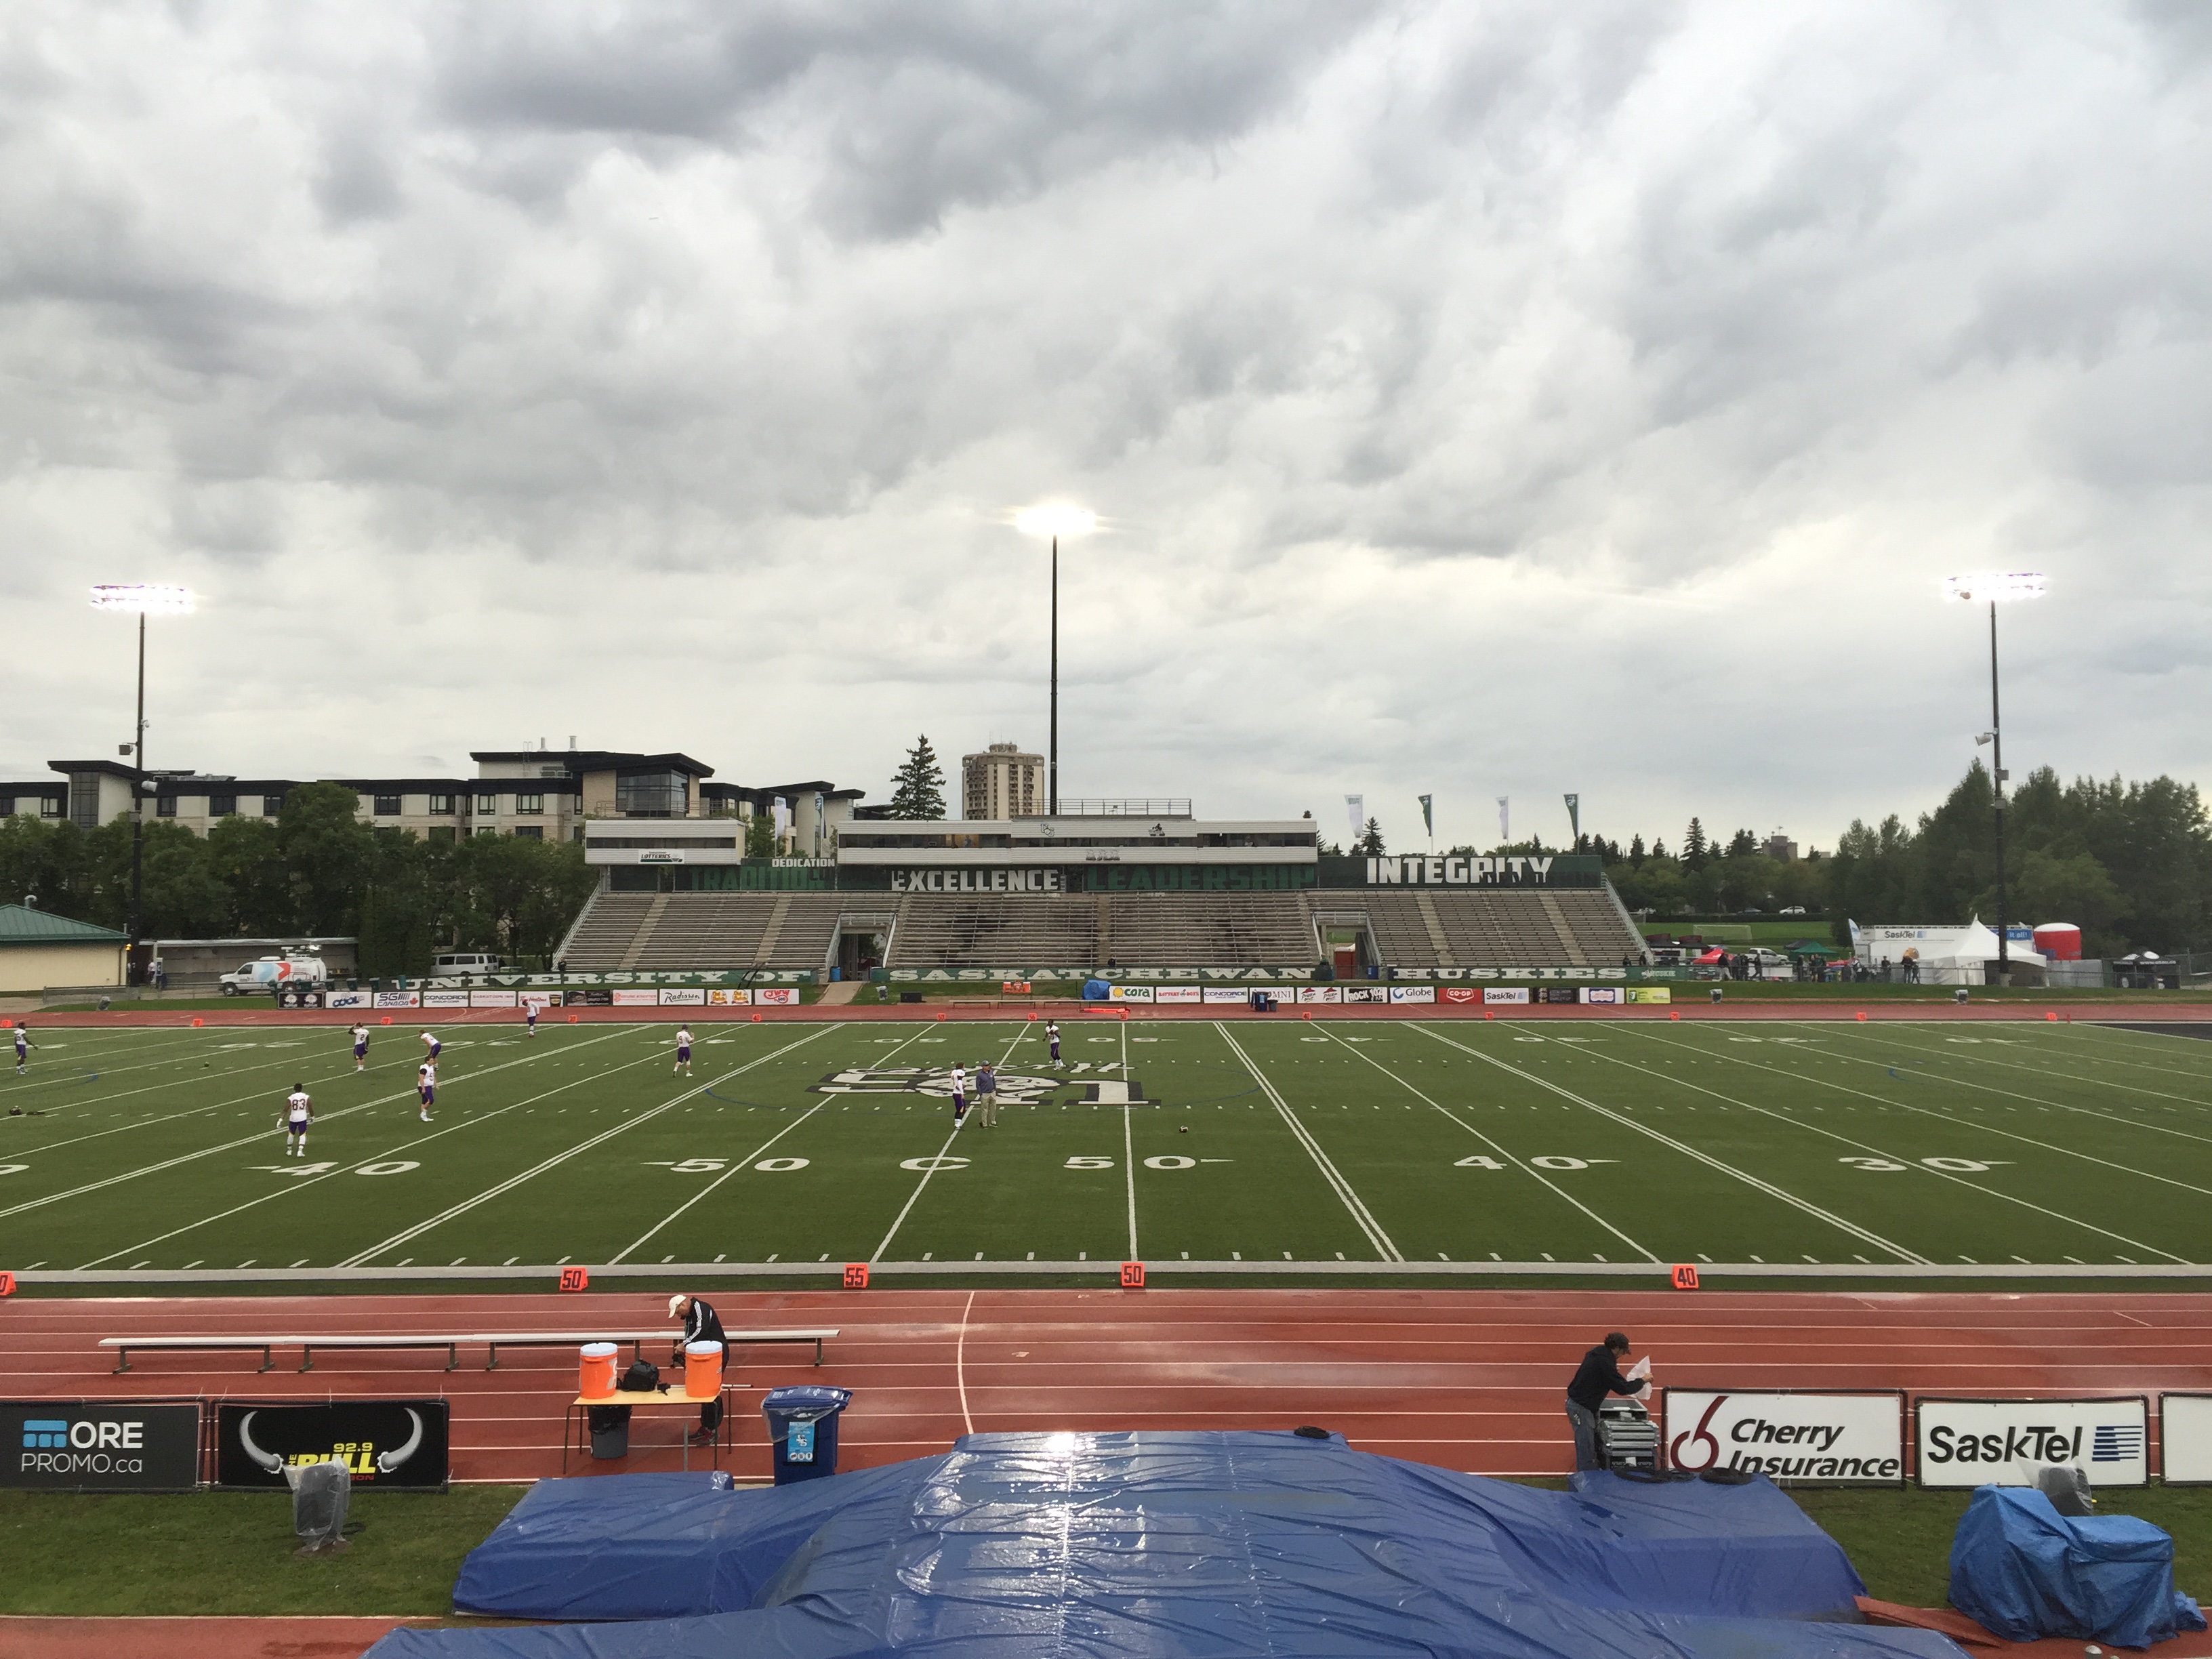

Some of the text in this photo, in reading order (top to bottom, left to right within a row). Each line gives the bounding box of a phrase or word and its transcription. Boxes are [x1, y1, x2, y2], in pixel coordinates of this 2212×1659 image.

[771, 859, 835, 867] DEDICATION
[1366, 857, 1553, 884] INTEGRITY
[891, 869, 1060, 891] EXCELLENCE
[1086, 865, 1314, 890] LEADERSHIP
[391, 968, 1628, 990] UNIVERSITY OF SASKATCHEWAN HUSKIES
[664, 991, 701, 1003] Radisson
[1124, 988, 1151, 998] cora
[1349, 989, 1369, 1002] ROCK
[1406, 988, 1432, 996] Globe
[1486, 991, 1517, 1000] SaskTel
[292, 1098, 306, 1111] 83
[271, 1161, 421, 1176] 40
[670, 1158, 811, 1173] 50
[899, 1155, 972, 1171] C
[1062, 1155, 1197, 1170] 50
[1452, 1155, 1590, 1170] 40
[1837, 1156, 1991, 1172] 30
[562, 1270, 581, 1289] 50
[845, 1267, 864, 1286] 55
[1124, 1265, 1141, 1284] 50
[1677, 1268, 1696, 1286] 40
[70, 1421, 143, 1450] ORE
[1730, 1418, 1845, 1452] Cherry
[333, 1442, 373, 1452] 92.9
[1927, 1425, 2083, 1464] SaskTel
[21, 1453, 143, 1473] PROMO.ca
[1727, 1451, 1900, 1478] Insurance
